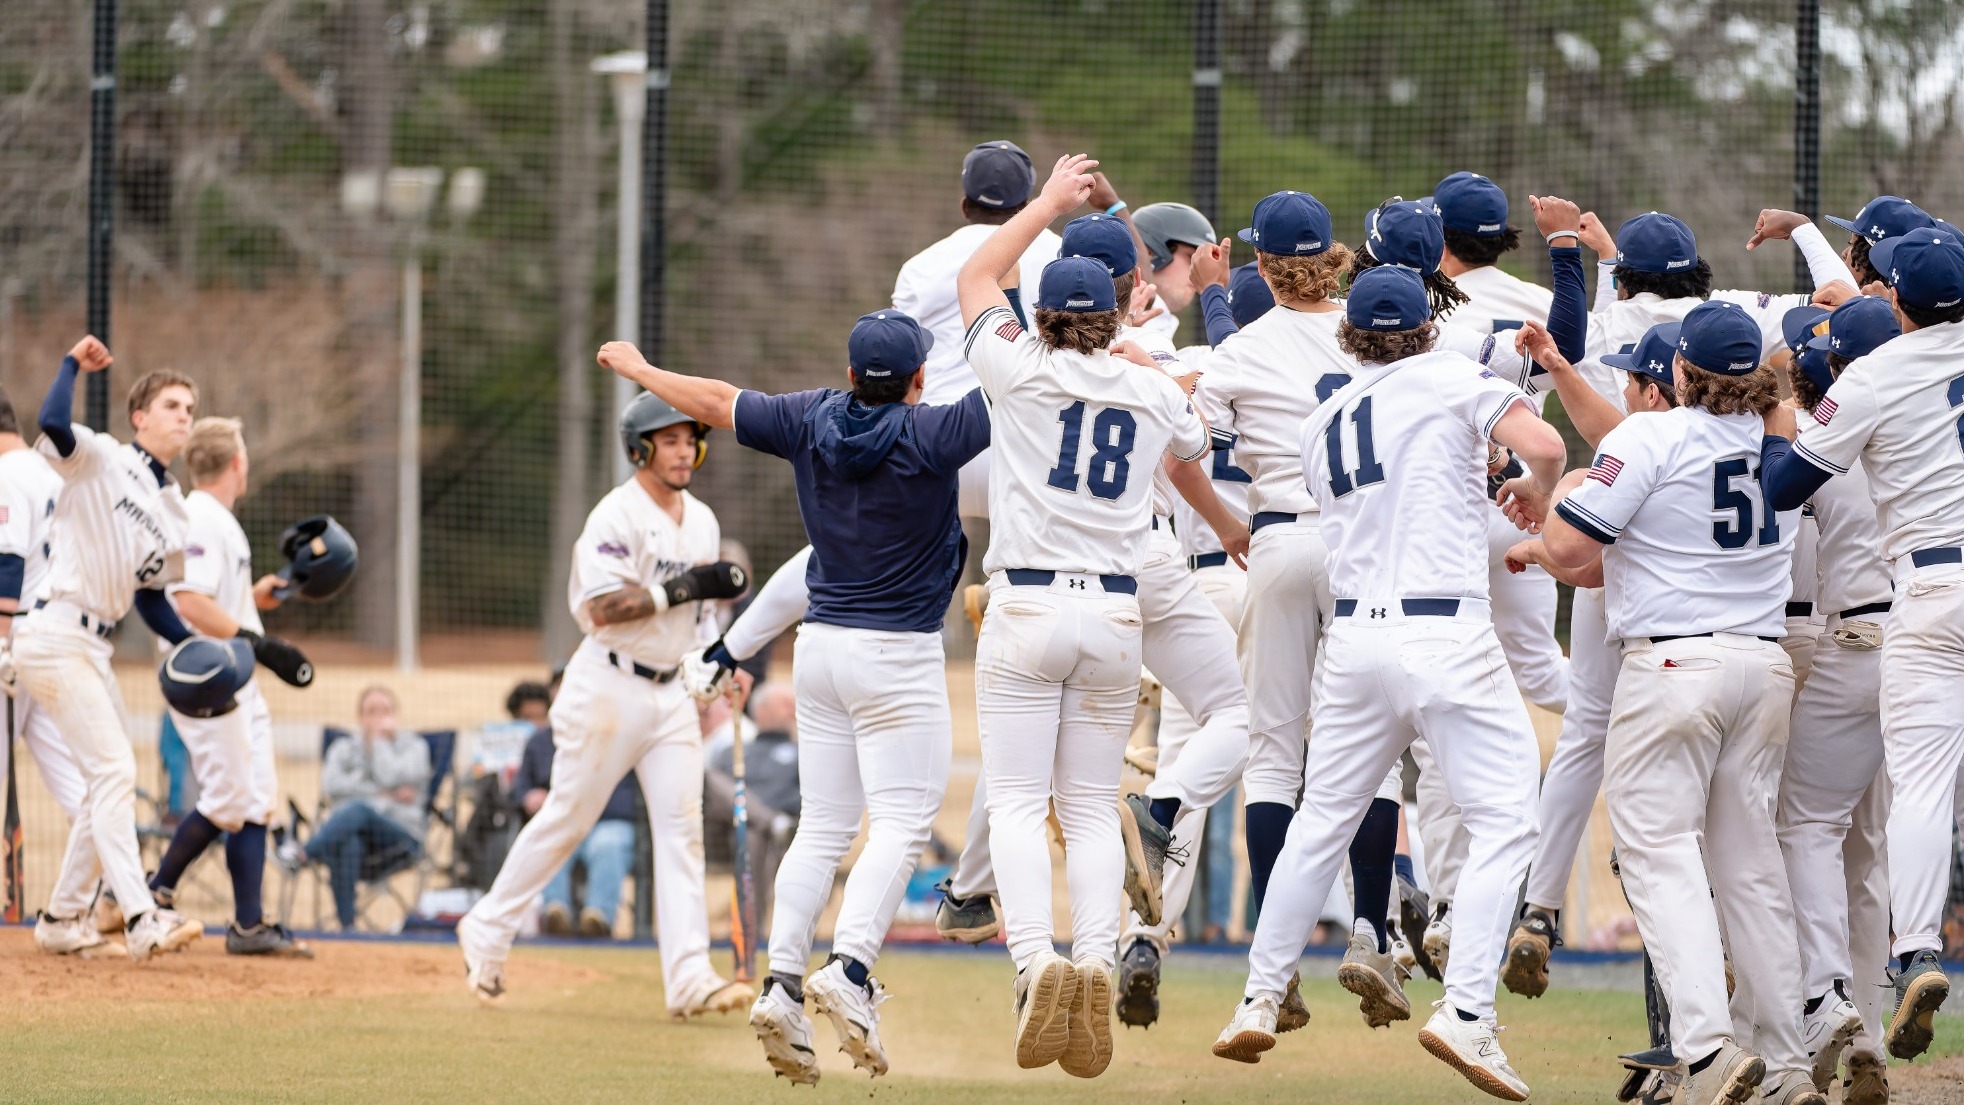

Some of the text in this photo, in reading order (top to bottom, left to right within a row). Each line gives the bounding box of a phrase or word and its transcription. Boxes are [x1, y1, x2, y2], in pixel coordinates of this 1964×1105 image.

[1046, 400, 1138, 501] 18
[1324, 395, 1388, 501] 11
[1711, 454, 1780, 551] 51
[135, 550, 164, 583] 12
